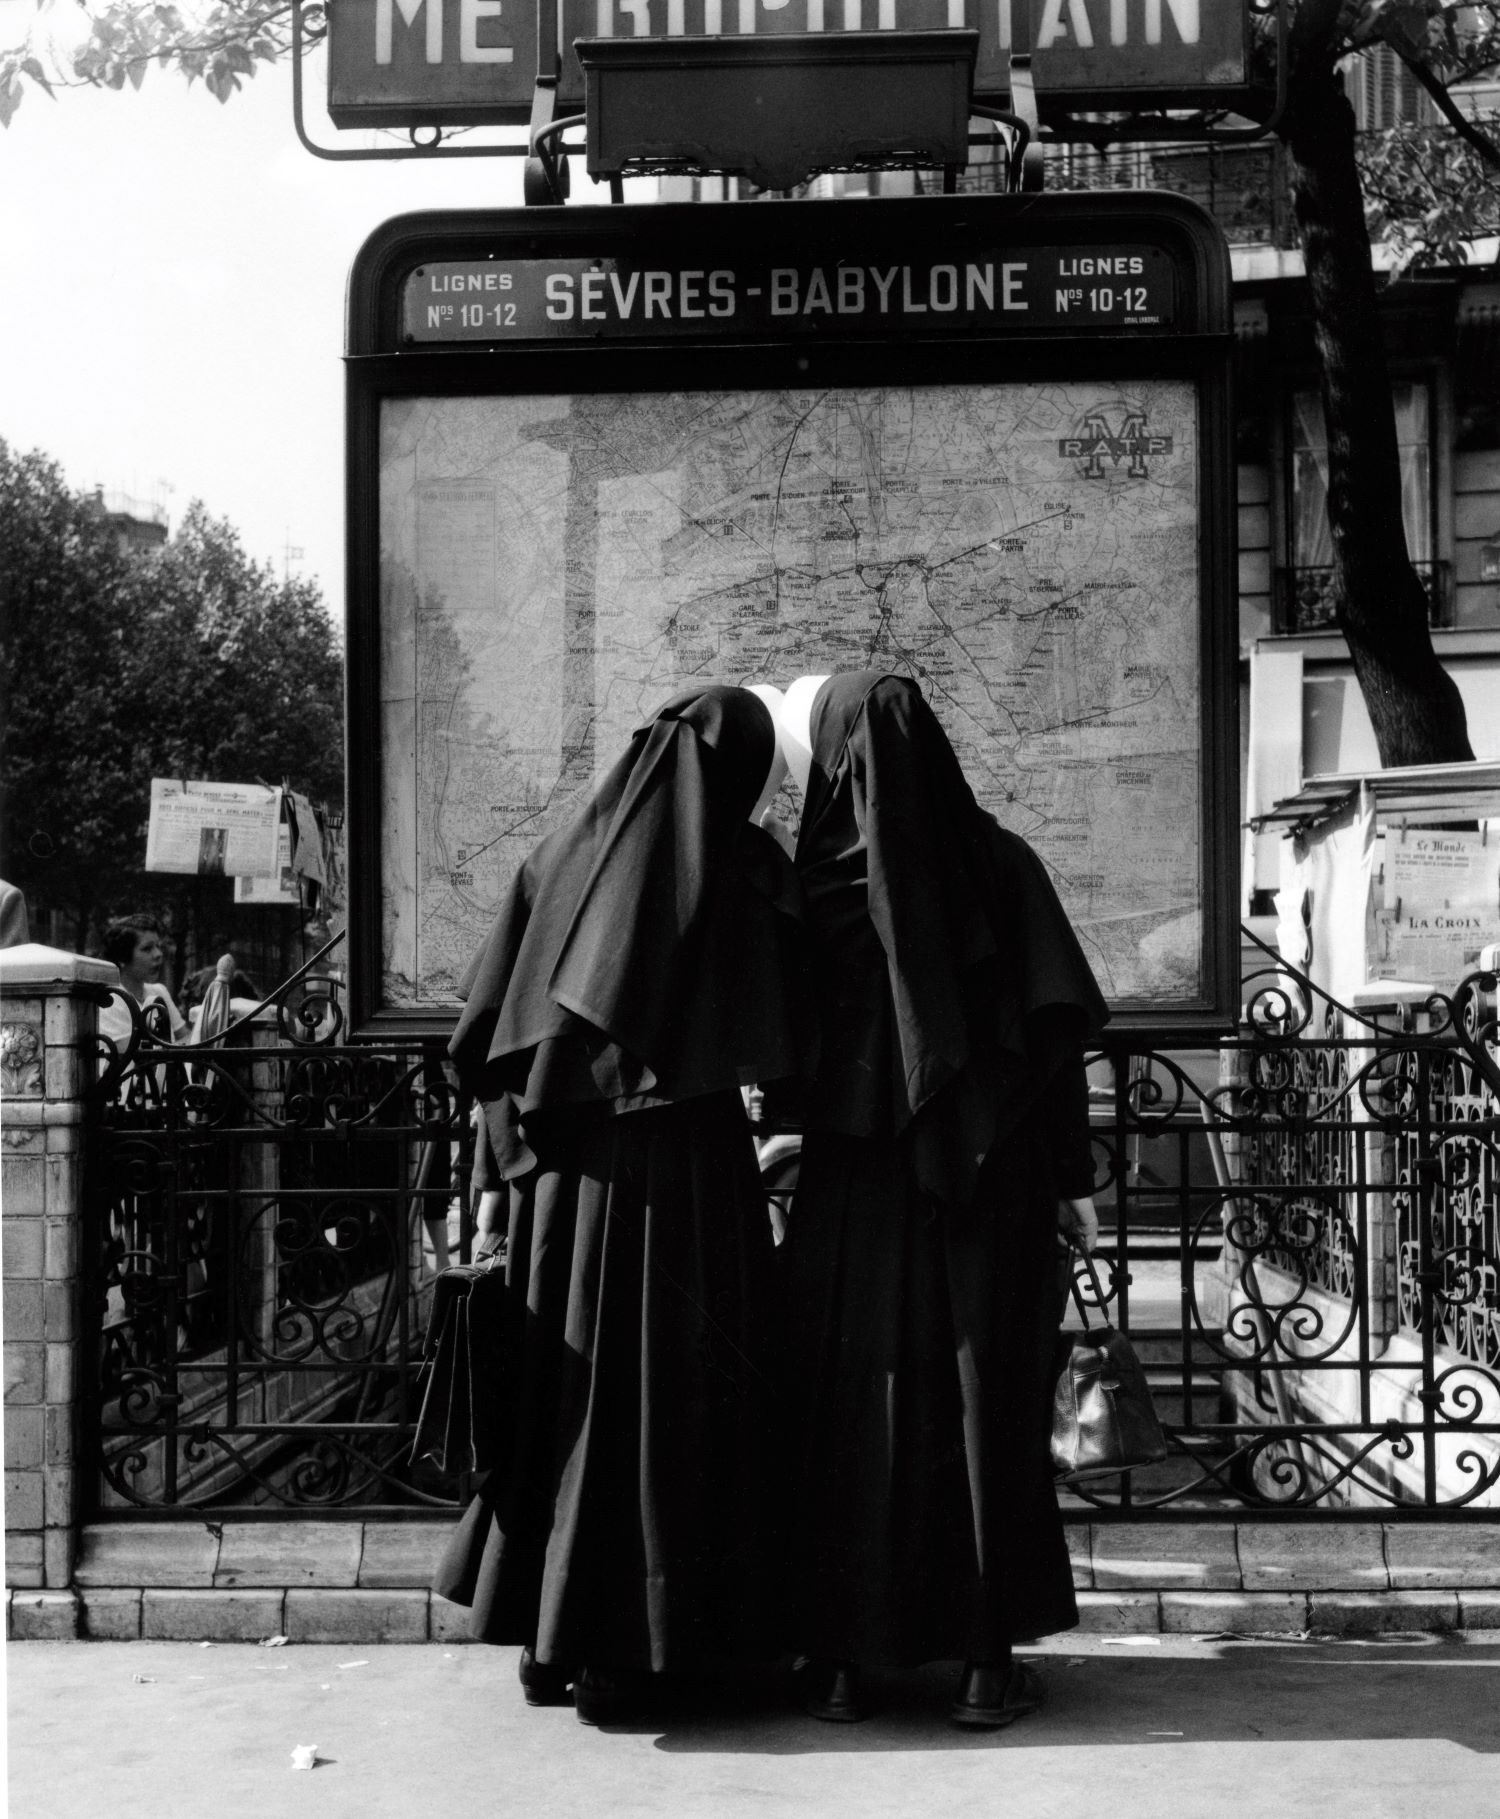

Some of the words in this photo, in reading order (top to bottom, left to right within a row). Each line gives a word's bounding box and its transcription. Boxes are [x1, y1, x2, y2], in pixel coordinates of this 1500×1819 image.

[1059, 257, 1143, 276] LIGNES
[431, 274, 513, 292] LIGNES
[1089, 288, 1147, 312] 10-12
[460, 303, 516, 327] 10-12
[1417, 840, 1429, 851] Le
[1431, 840, 1466, 853] Monde
[1434, 916, 1481, 929] CROIX
